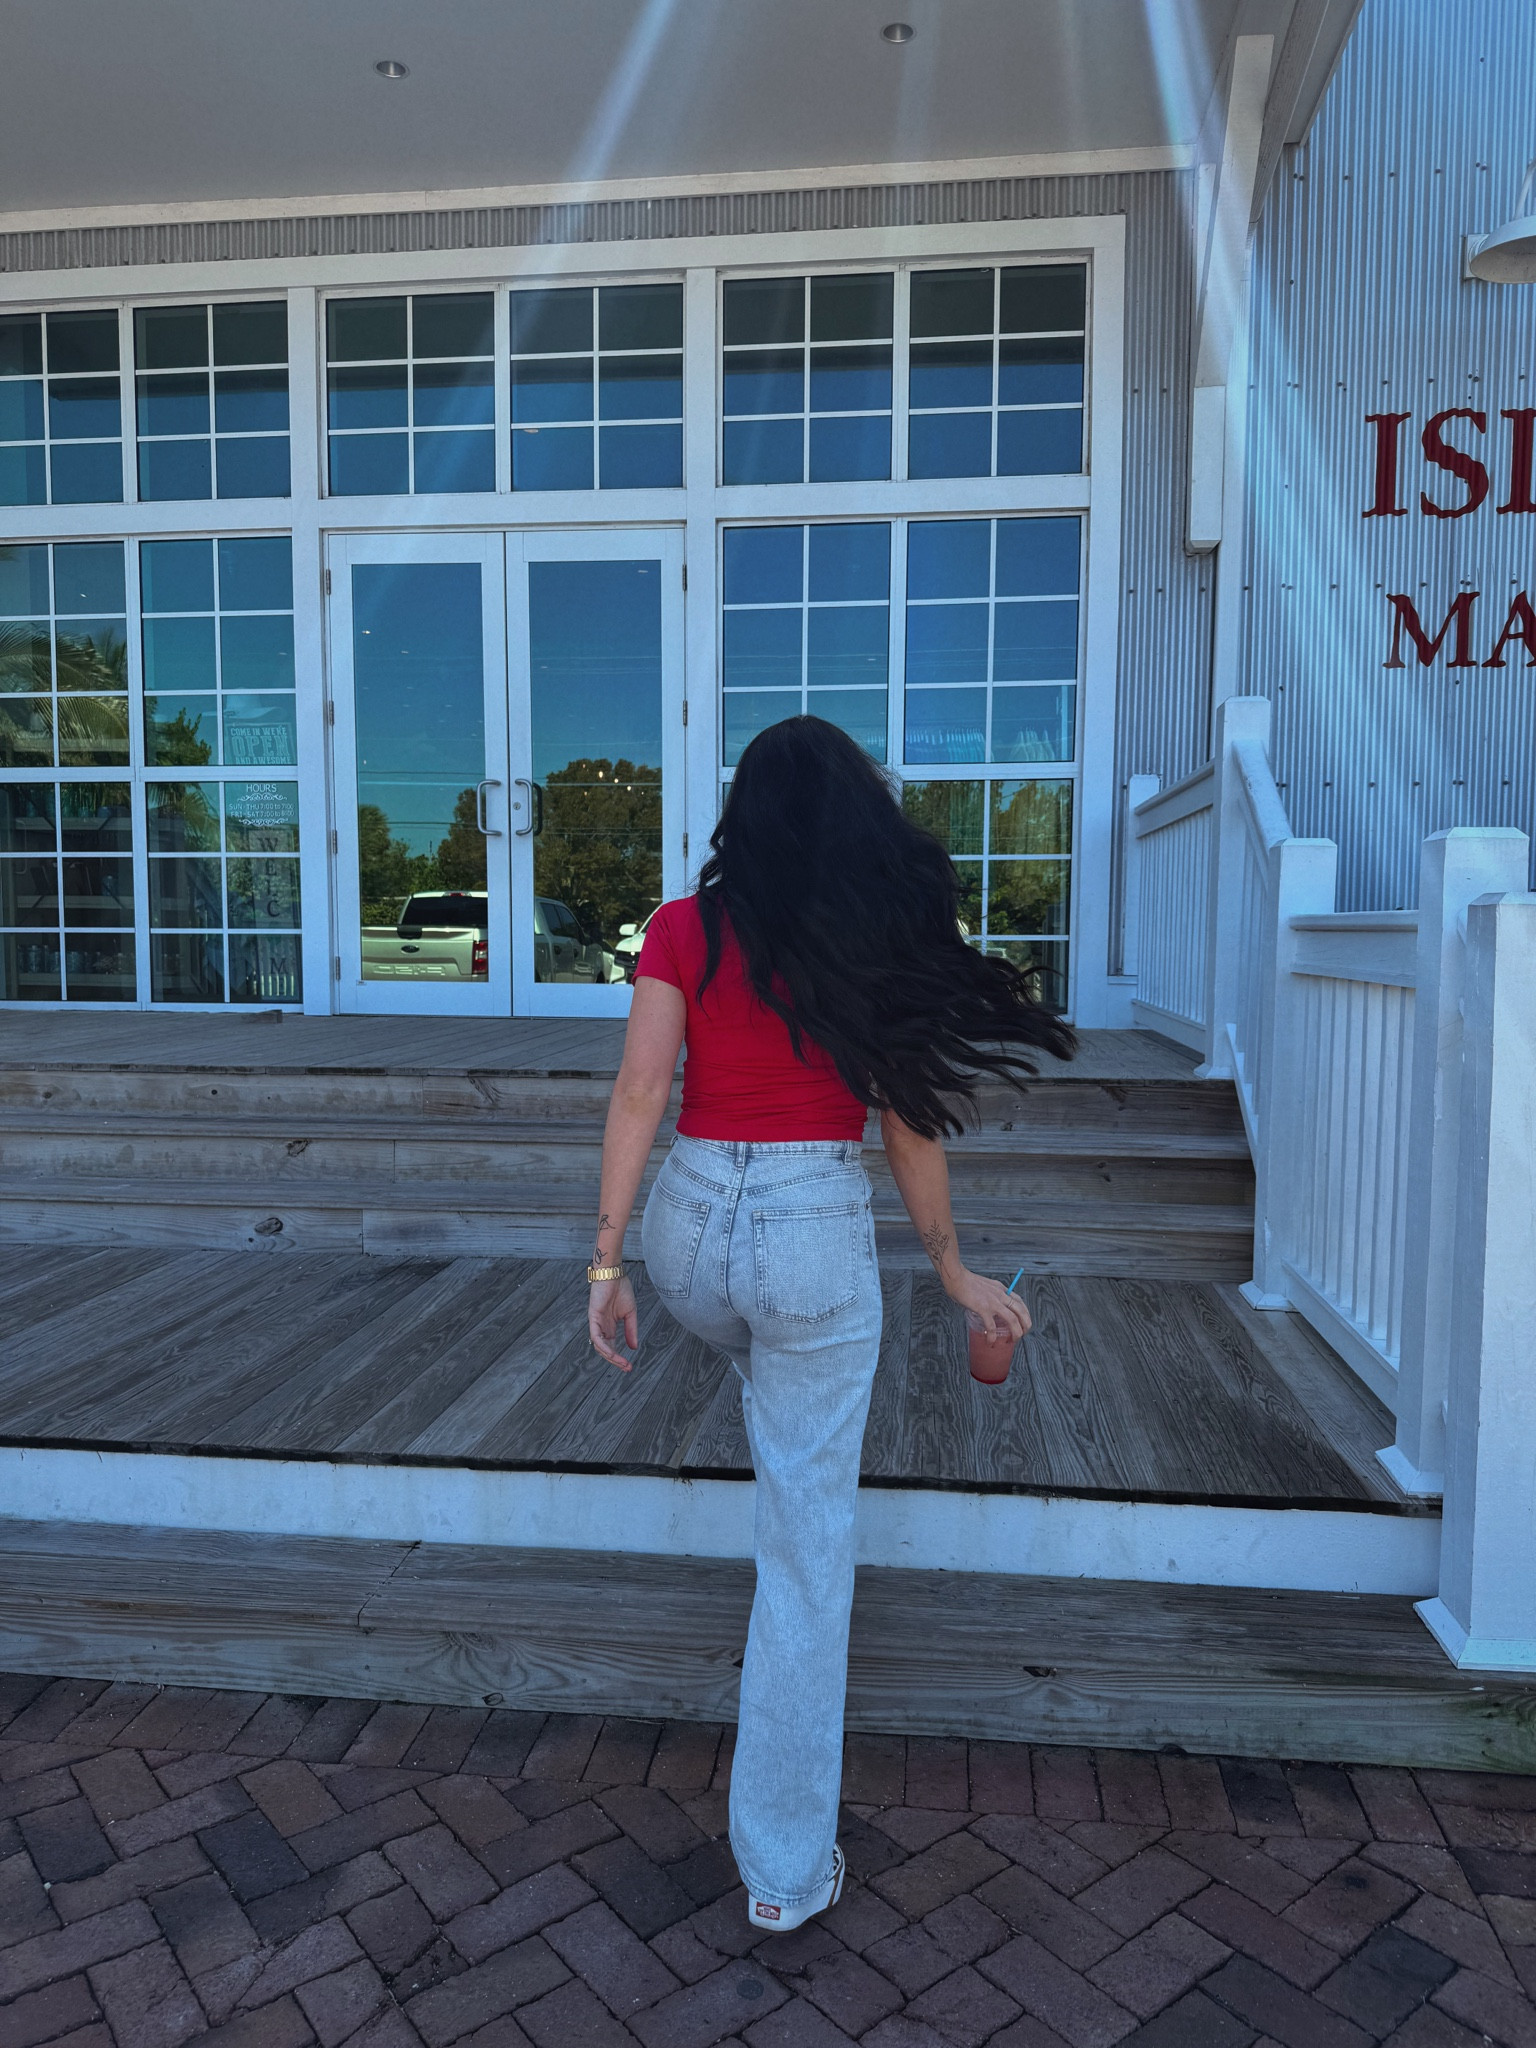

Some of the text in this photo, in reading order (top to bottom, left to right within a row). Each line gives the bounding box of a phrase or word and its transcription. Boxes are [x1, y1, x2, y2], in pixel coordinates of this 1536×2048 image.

[1382, 590, 1536, 668] MA
[231, 728, 252, 736] COME
[253, 728, 261, 736] IN
[232, 736, 290, 757] OPEN
[235, 756, 292, 765] AND AWESOME
[246, 783, 277, 793] HOURS
